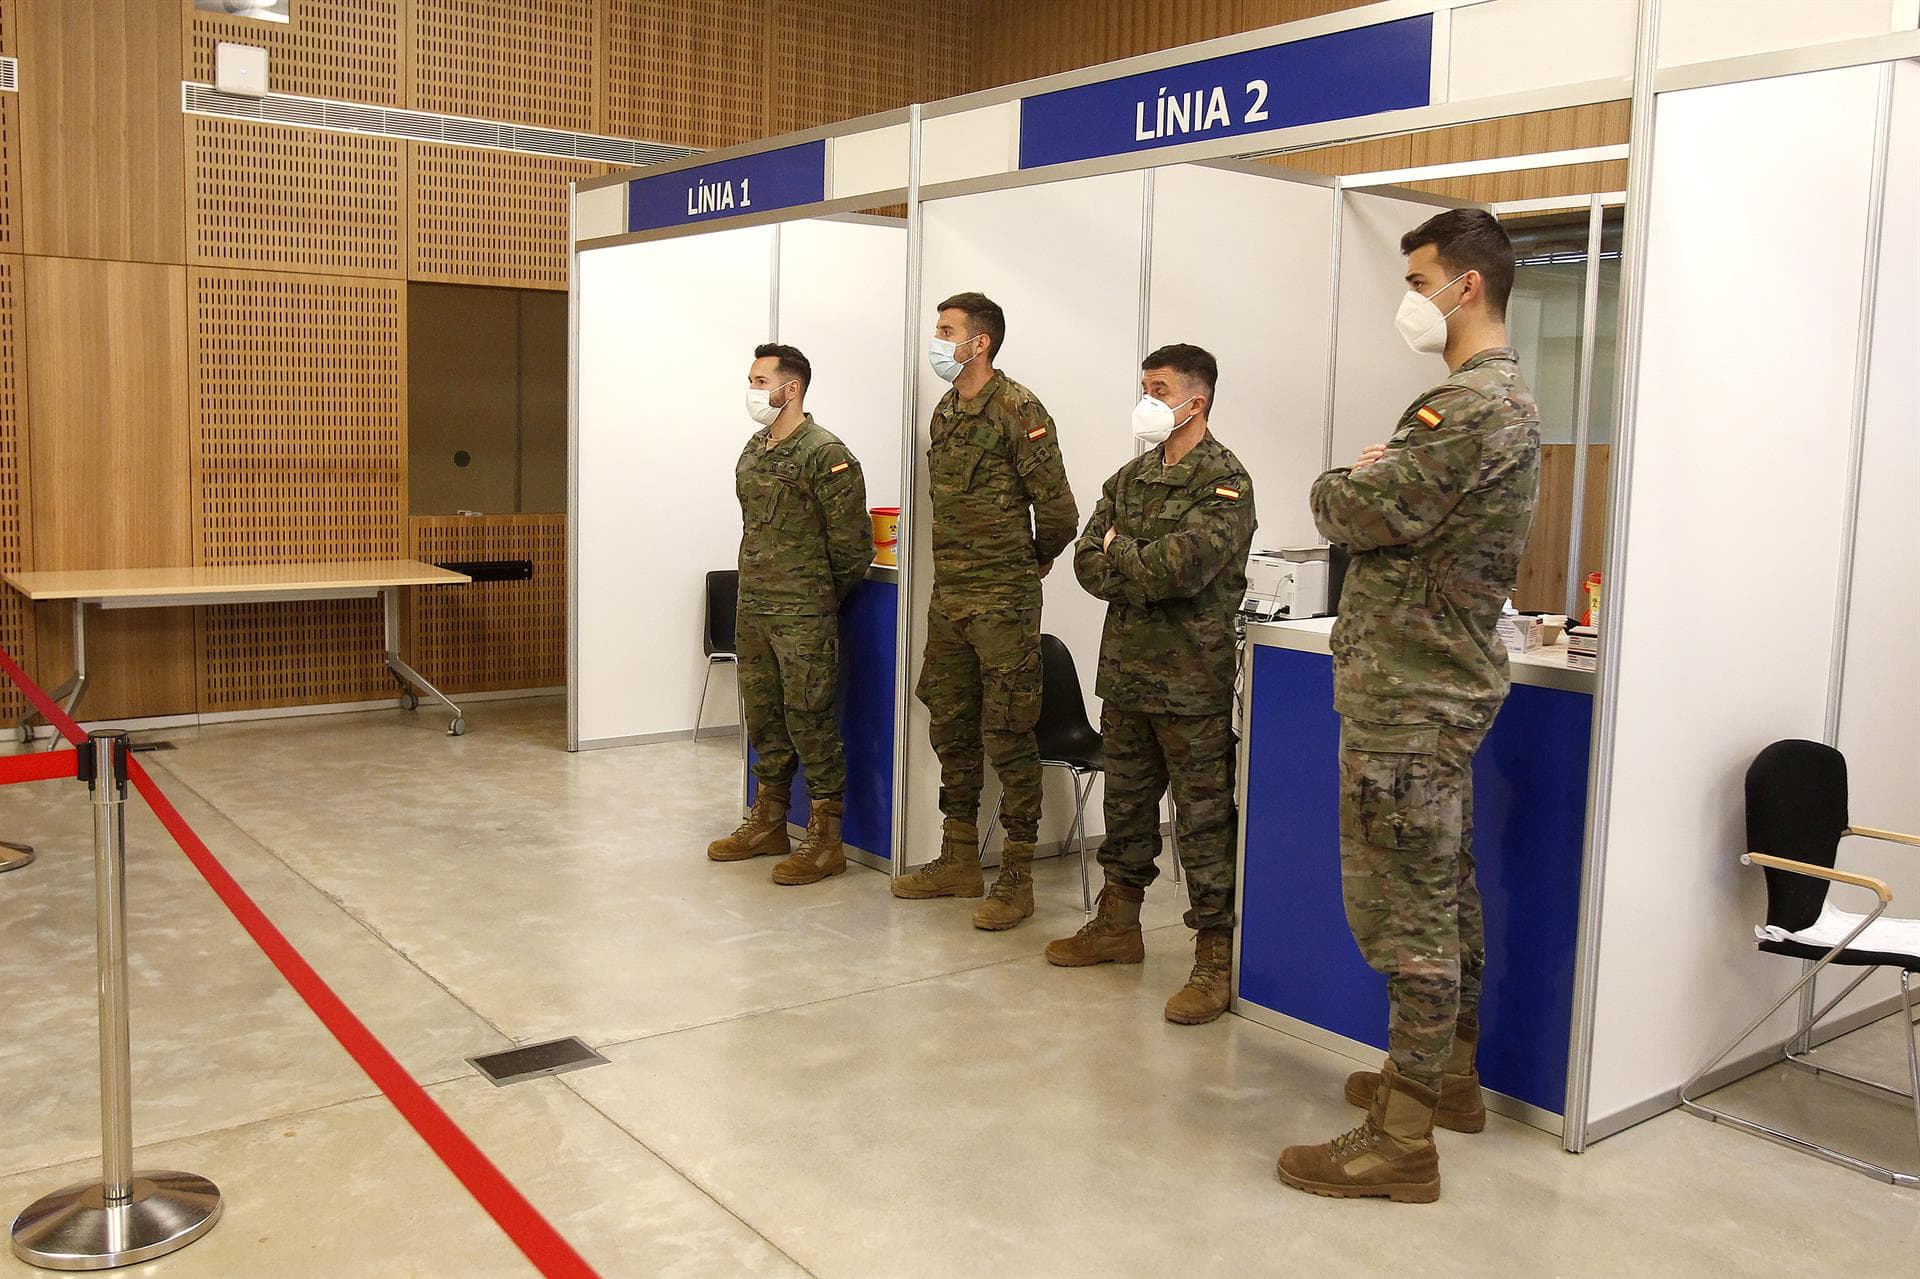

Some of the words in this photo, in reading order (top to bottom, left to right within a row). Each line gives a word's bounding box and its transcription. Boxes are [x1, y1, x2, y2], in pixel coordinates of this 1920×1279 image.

[1135, 86, 1231, 142] LÍNIA
[1244, 79, 1269, 124] 2
[687, 178, 735, 216] LÍNIA
[740, 178, 751, 208] 1
